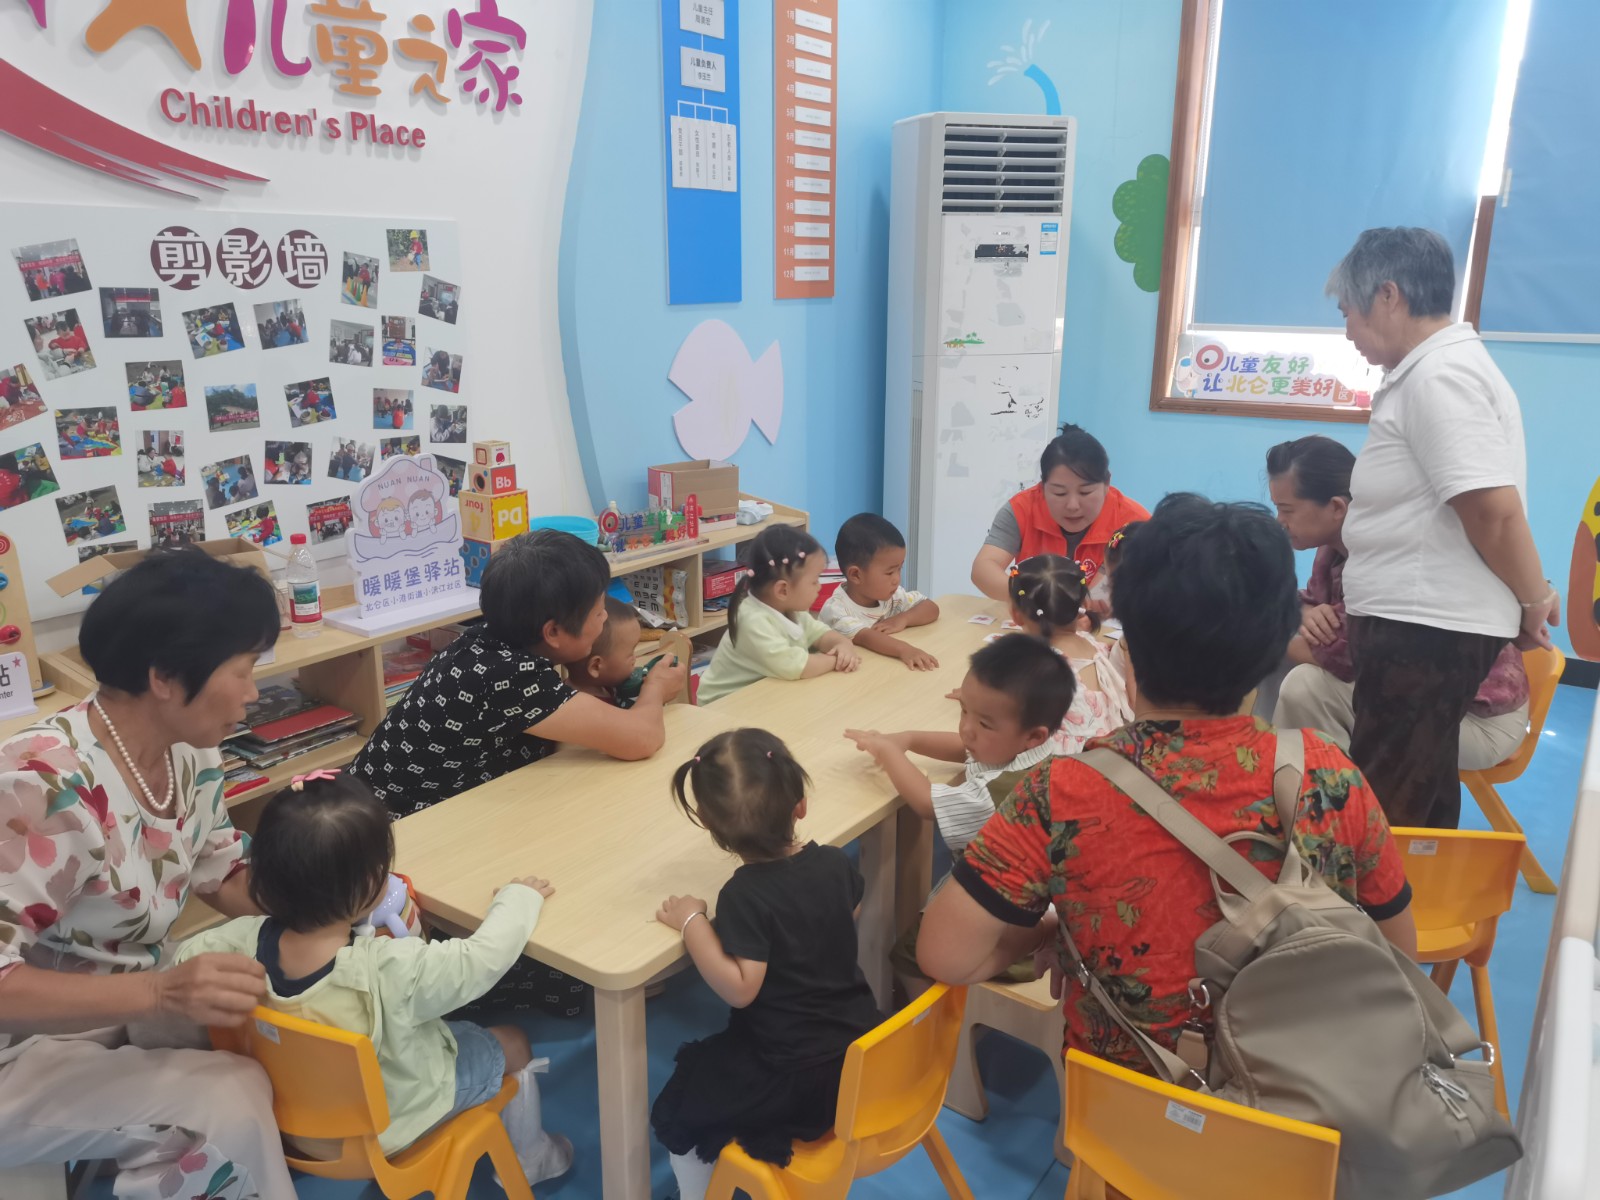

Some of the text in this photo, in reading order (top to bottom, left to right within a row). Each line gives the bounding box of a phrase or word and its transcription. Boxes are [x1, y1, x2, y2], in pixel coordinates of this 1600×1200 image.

[786, 10, 795, 20] 1月
[786, 34, 795, 45] 2月
[786, 59, 795, 69] 3月
[786, 84, 795, 93] 4月
[786, 107, 794, 118] 5月
[160, 87, 426, 149] Children's Place
[786, 132, 794, 141] 6月
[786, 155, 794, 165] 7月
[786, 179, 794, 188] 8月
[785, 202, 794, 211] 9月
[783, 225, 794, 234] 10月
[783, 247, 794, 256] 11月
[152, 231, 326, 287] 剪影墙
[783, 270, 794, 279] 12月
[1221, 356, 1310, 375] 儿童友好
[1203, 373, 1334, 397] 让北仑更美好
[378, 475, 430, 491] NUAN NUAN
[495, 476, 512, 489] Bb
[464, 499, 484, 513] four
[362, 557, 460, 597] 暖暖堡驿站
